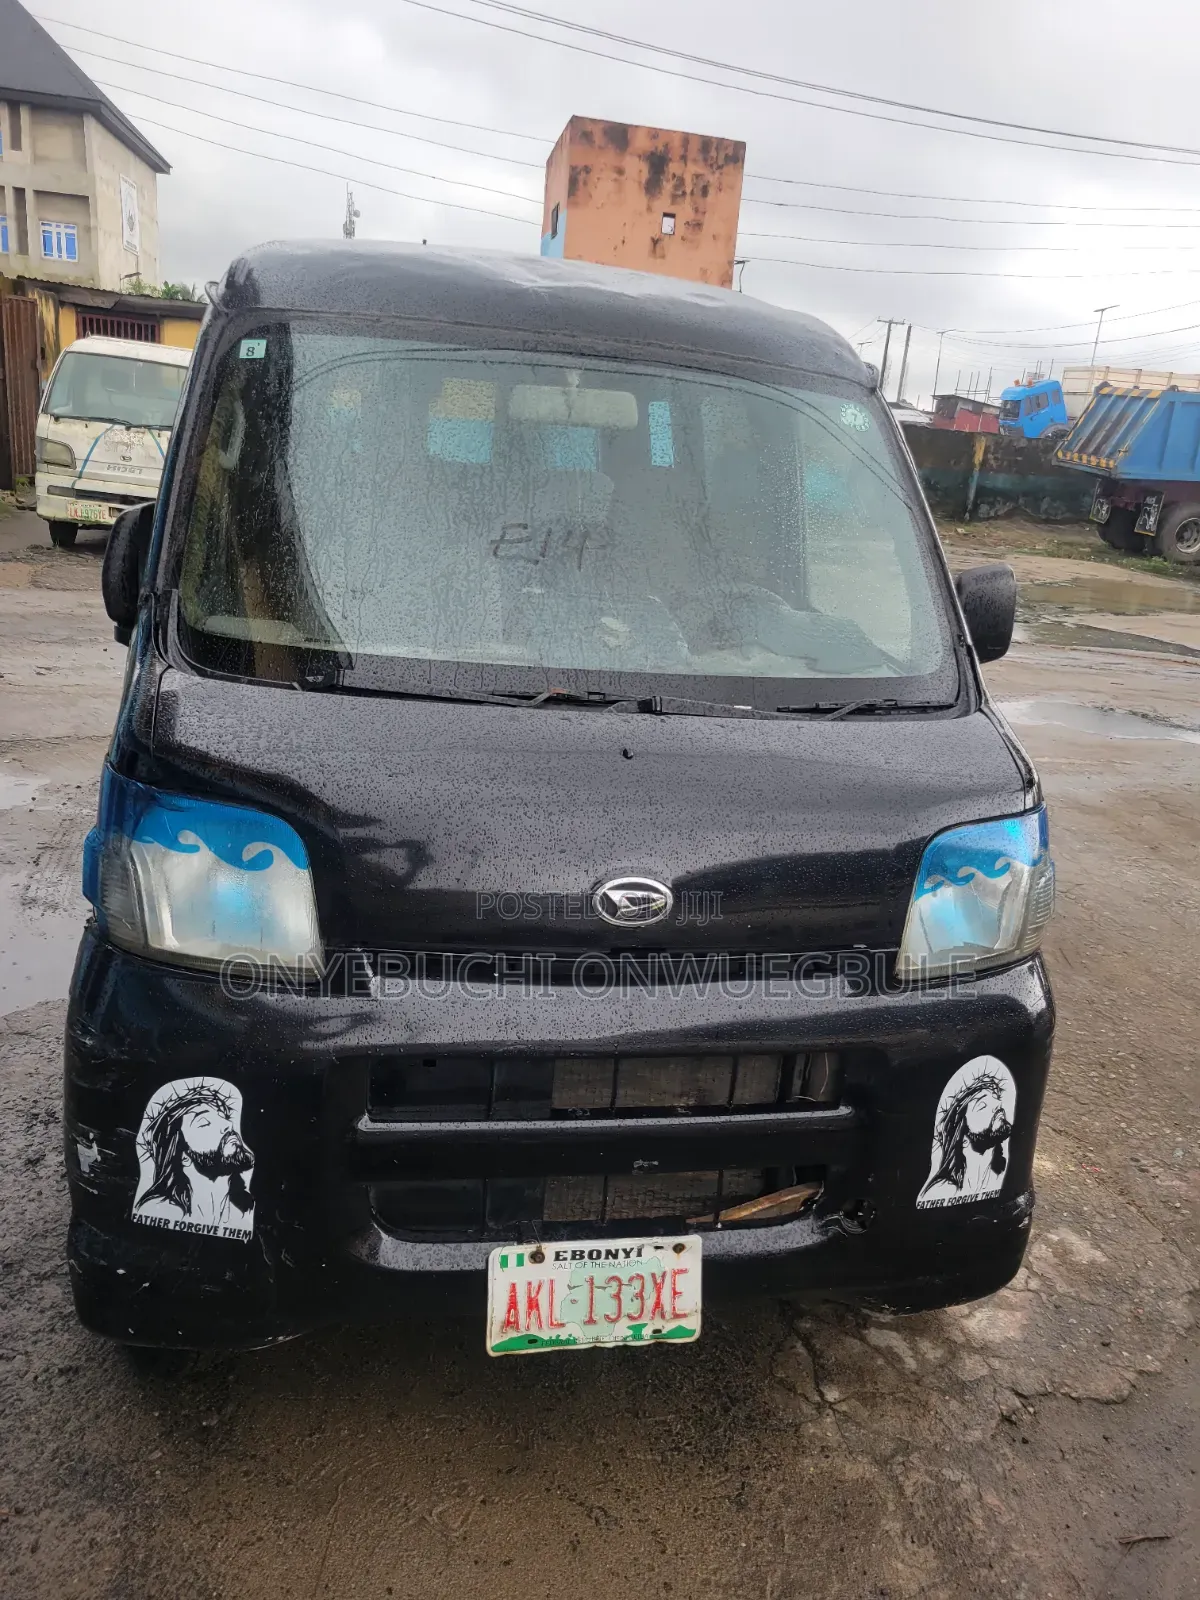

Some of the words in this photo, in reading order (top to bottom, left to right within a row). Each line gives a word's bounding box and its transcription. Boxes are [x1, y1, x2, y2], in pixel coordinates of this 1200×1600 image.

[917, 1198, 946, 1209] FATHER
[947, 1193, 980, 1206] FORGIVE
[981, 1189, 1001, 1199] THEM
[132, 1213, 171, 1229] FATHER
[173, 1220, 220, 1236] FORGIVE
[222, 1226, 253, 1240] THEM
[553, 1244, 645, 1262] EBONYI
[552, 1262, 572, 1270] SALT
[574, 1261, 588, 1269] OF
[590, 1261, 606, 1269] THE
[608, 1259, 643, 1269] NATION
